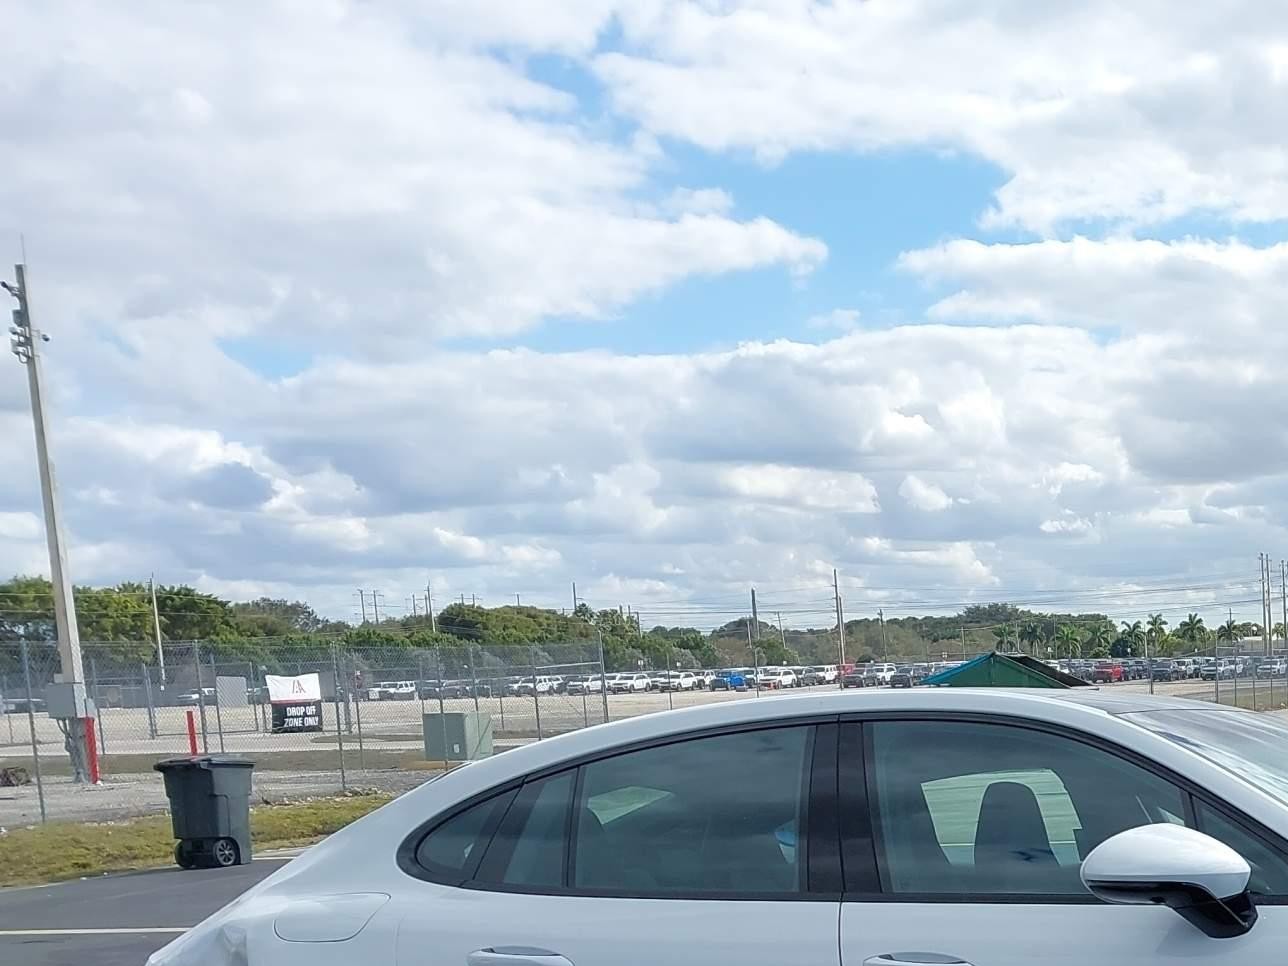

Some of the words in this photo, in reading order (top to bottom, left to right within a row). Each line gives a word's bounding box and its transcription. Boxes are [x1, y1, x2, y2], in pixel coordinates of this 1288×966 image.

[286, 706, 305, 717] DROP
[305, 705, 316, 716] OFF
[284, 717, 303, 728] ZONE
[304, 716, 319, 727] ONLY
